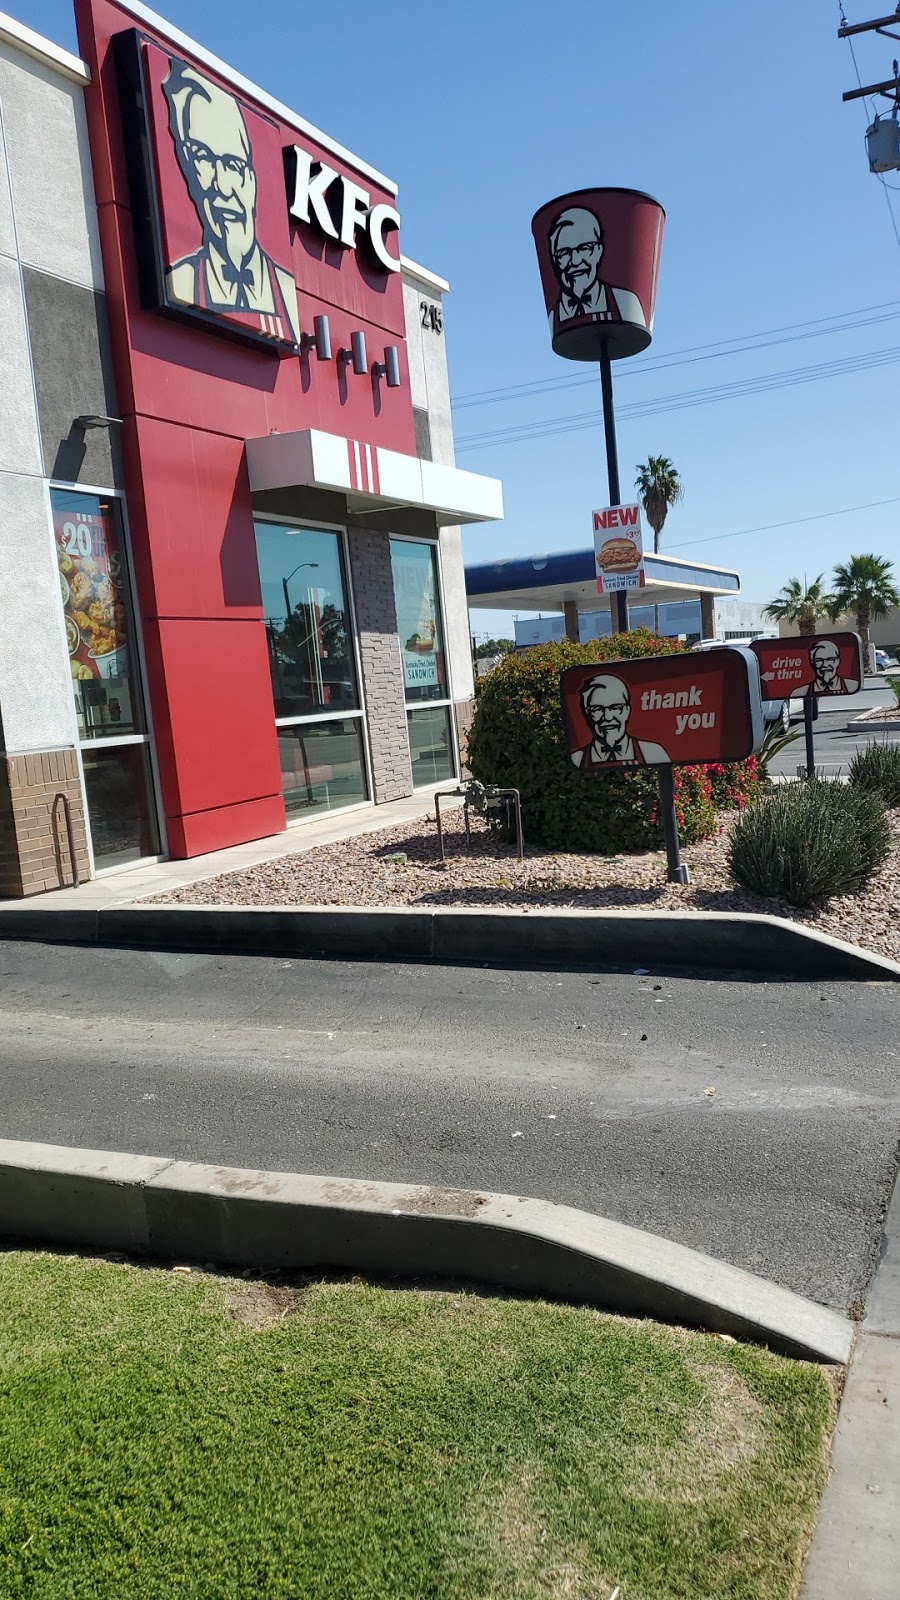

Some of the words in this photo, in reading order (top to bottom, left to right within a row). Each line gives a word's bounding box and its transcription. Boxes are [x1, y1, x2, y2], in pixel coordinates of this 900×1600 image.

[289, 144, 401, 273] KFC
[420, 301, 443, 336] 215
[594, 507, 639, 531] NEW
[61, 521, 92, 558] $20
[605, 580, 637, 589] SANDWICH
[408, 668, 435, 680] SANDWICH
[772, 656, 802, 669] drive
[777, 669, 802, 680] thru
[641, 685, 703, 711] thank
[675, 712, 715, 735] you
